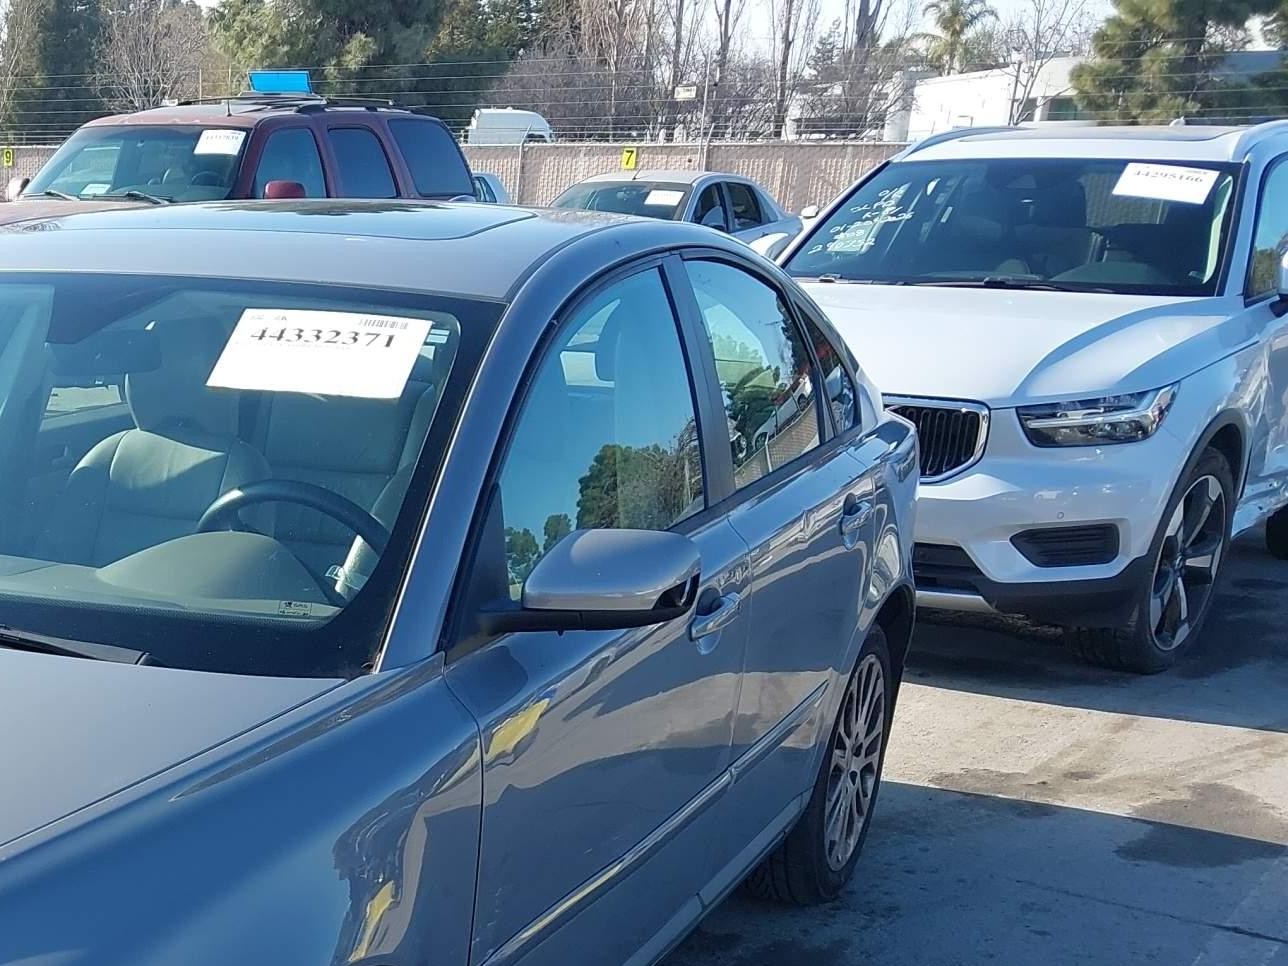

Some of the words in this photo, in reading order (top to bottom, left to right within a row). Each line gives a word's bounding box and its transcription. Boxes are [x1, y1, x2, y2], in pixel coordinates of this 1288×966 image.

[5, 151, 12, 164] 9
[625, 150, 634, 165] 7
[250, 327, 396, 348] 44332371
